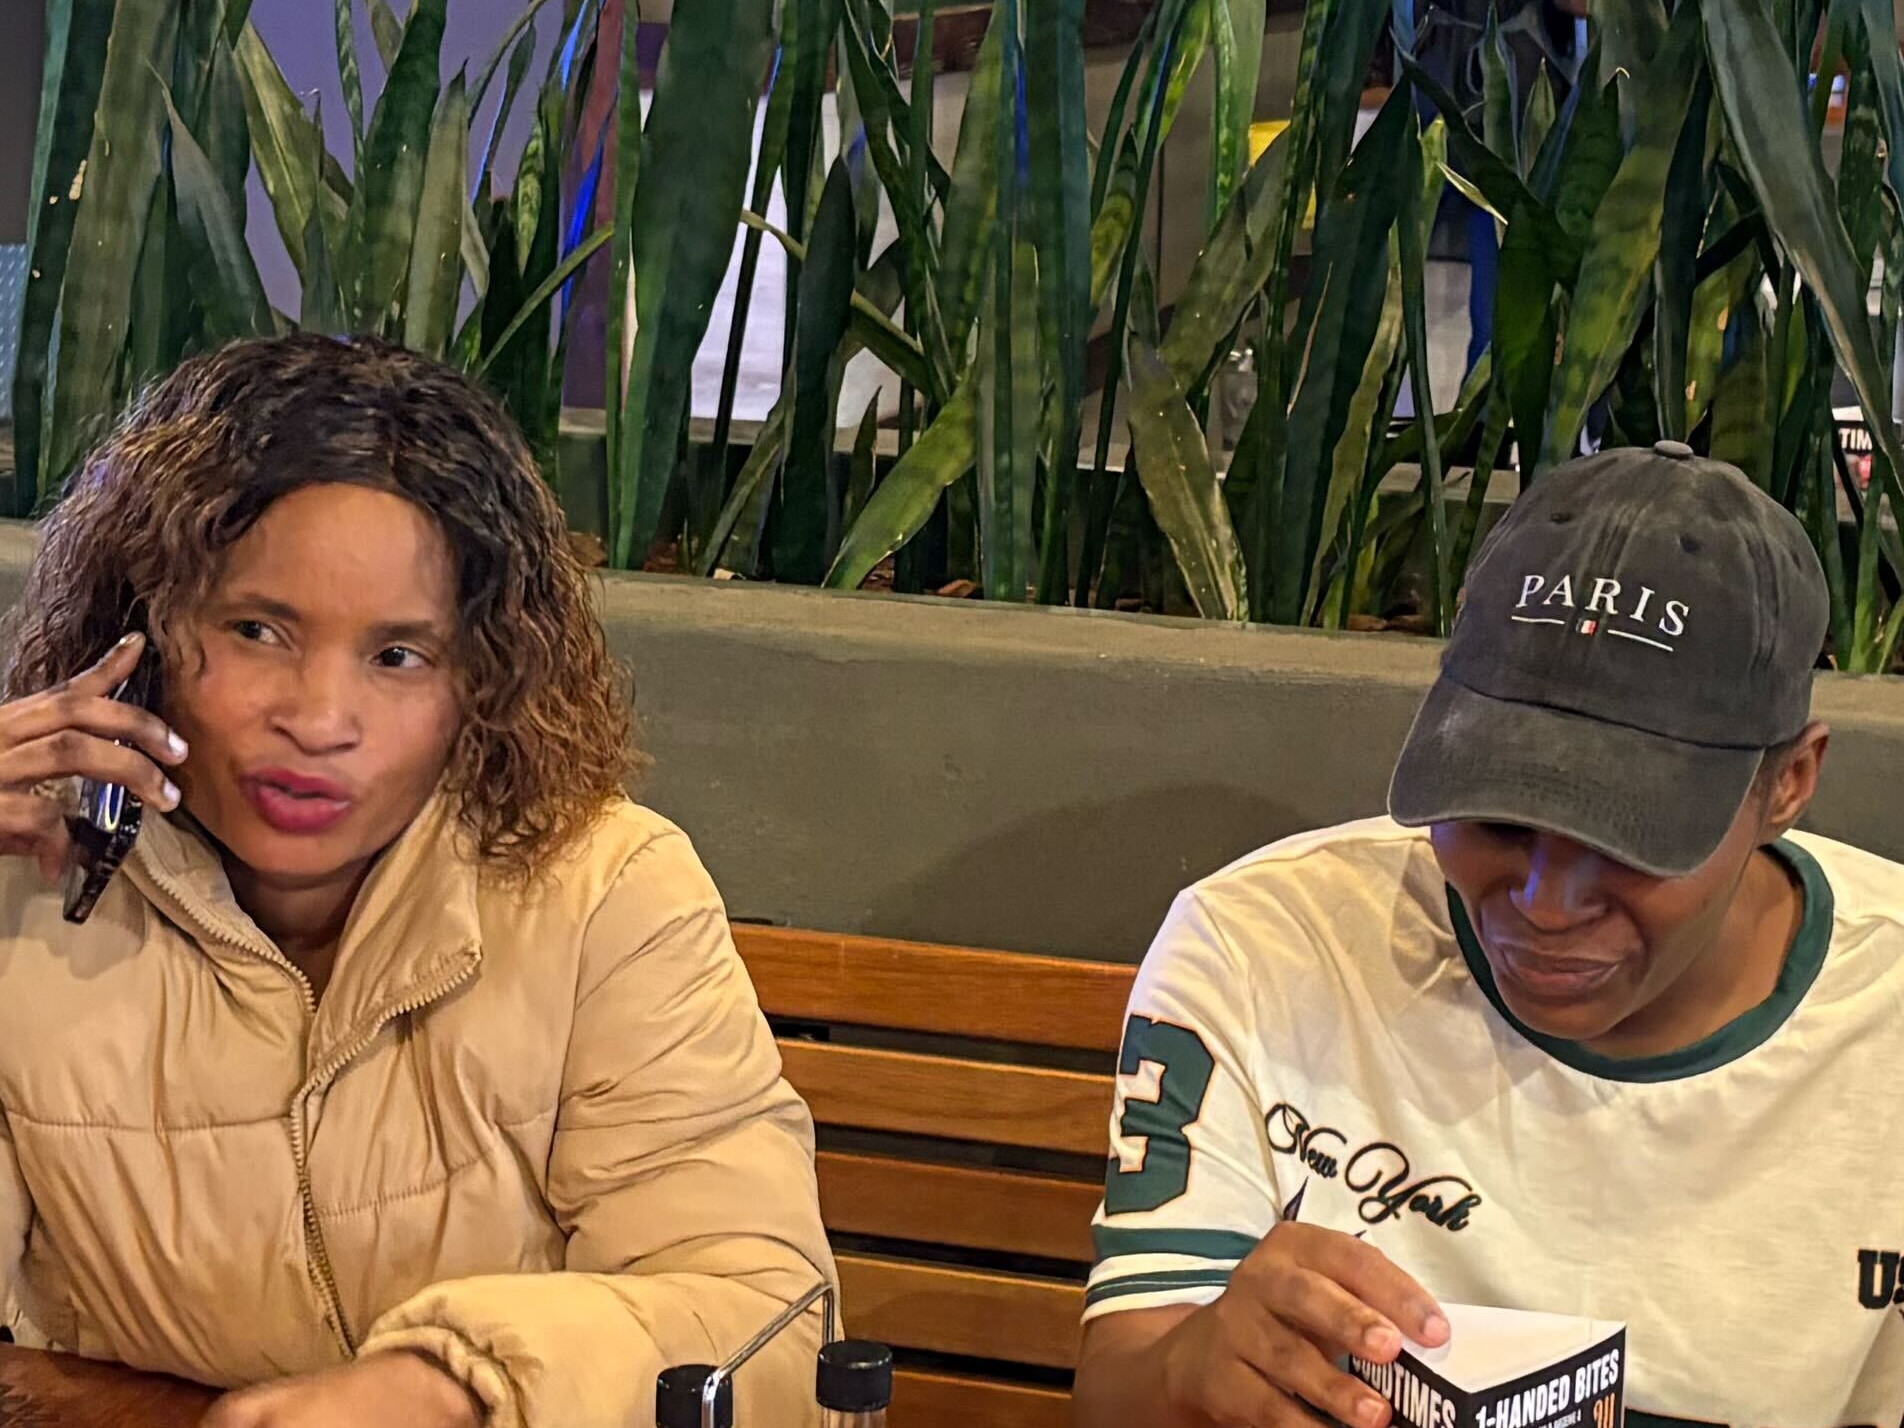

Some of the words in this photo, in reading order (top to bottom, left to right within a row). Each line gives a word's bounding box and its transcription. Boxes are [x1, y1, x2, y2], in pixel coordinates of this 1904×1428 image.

[1515, 574, 1689, 636] PARIS
[1264, 1103, 1347, 1178] New
[1345, 1142, 1482, 1232] York
[1574, 1348, 1619, 1404] BITES
